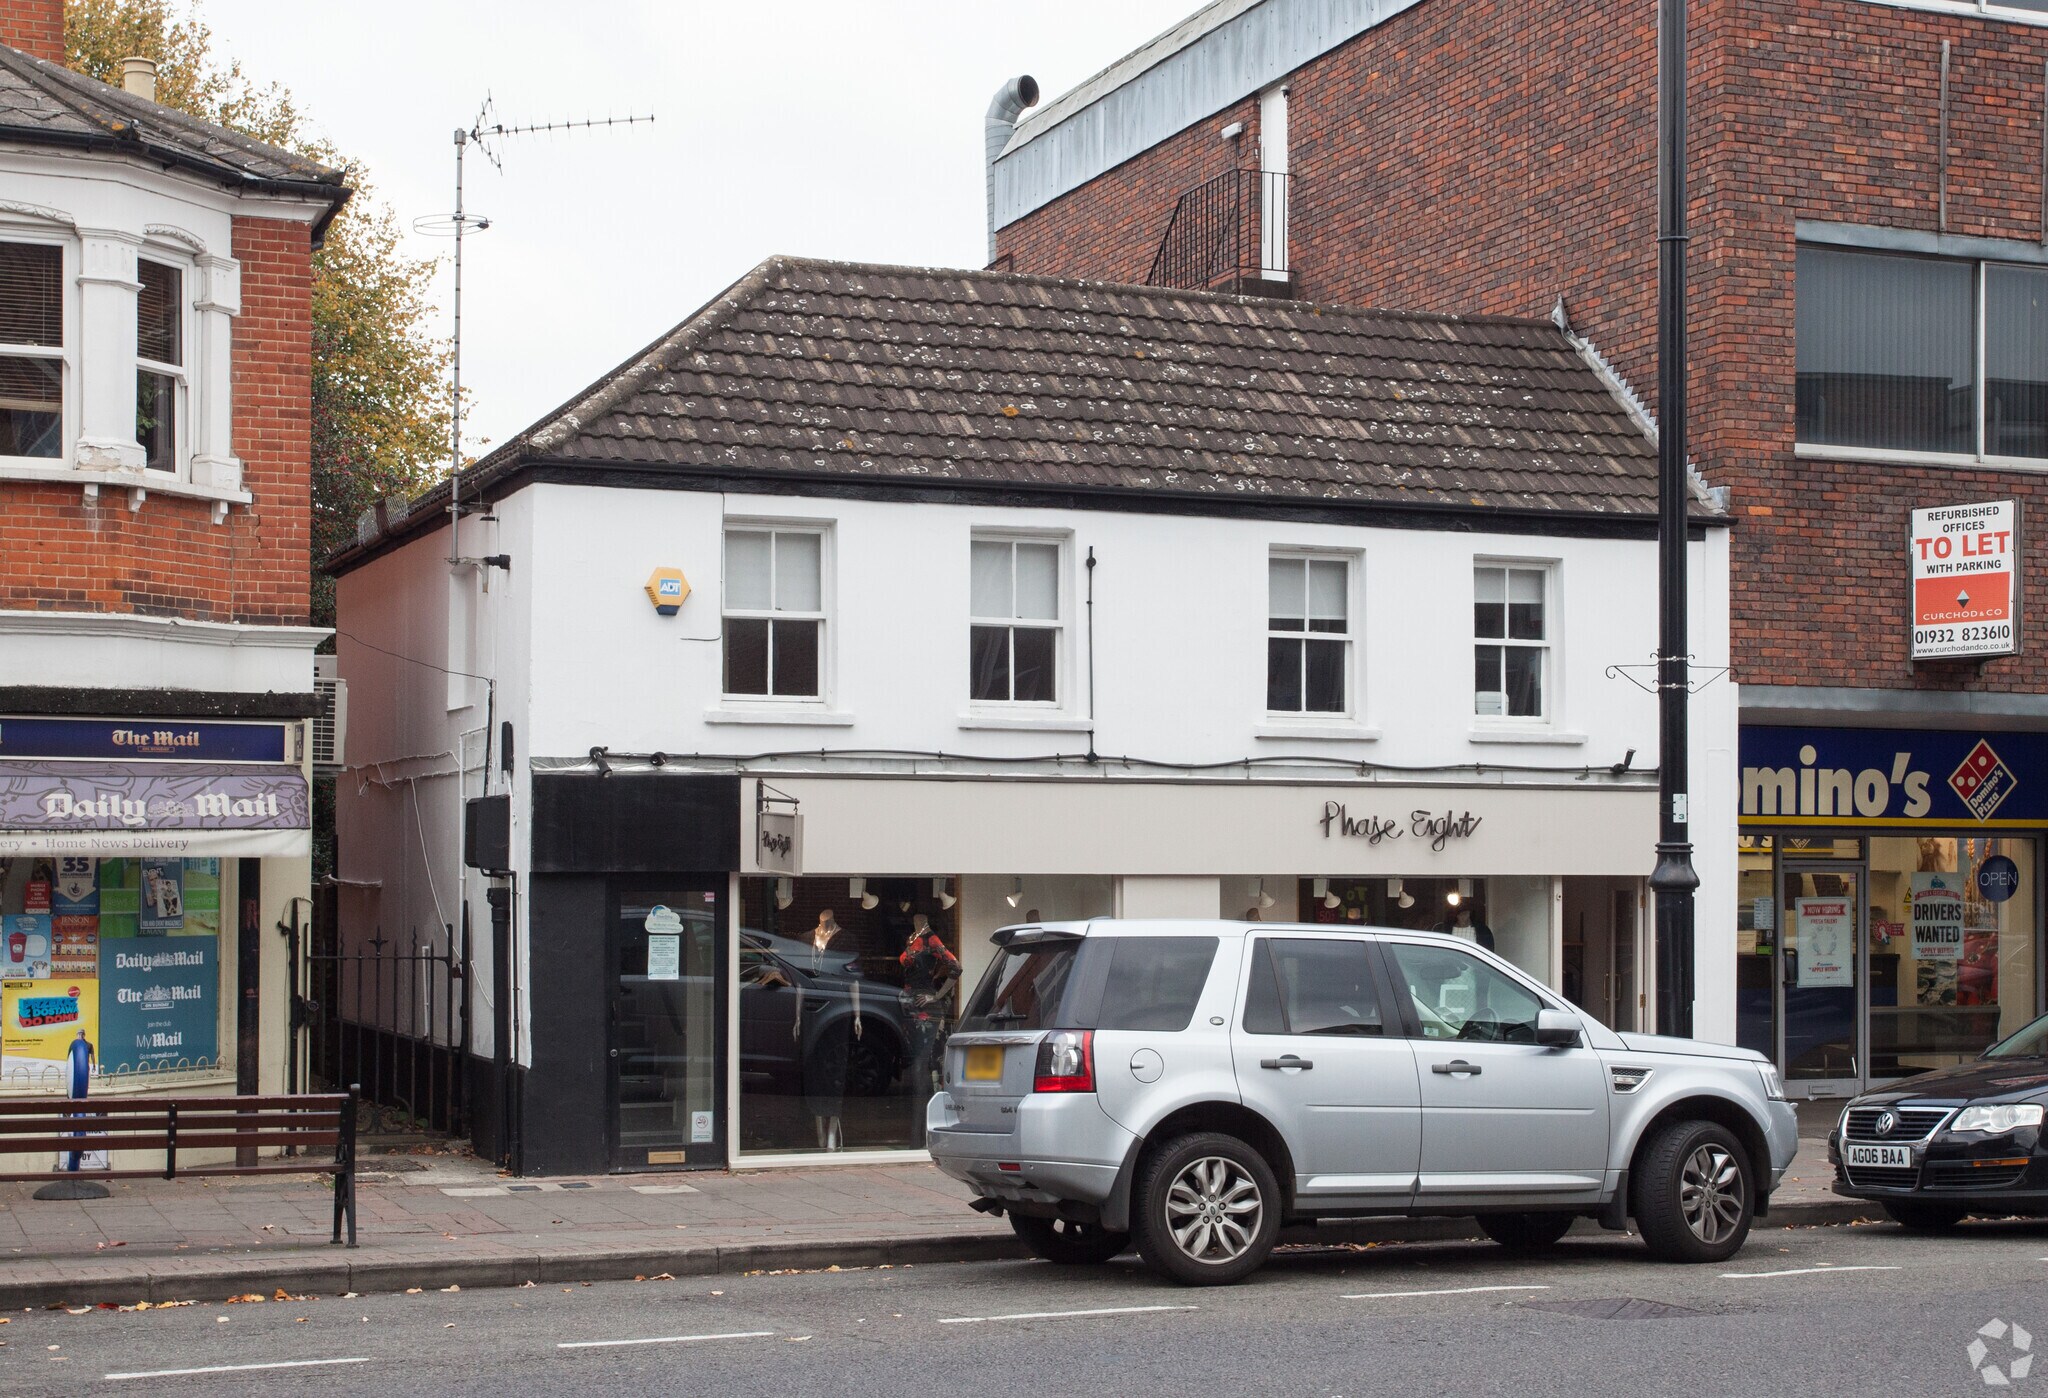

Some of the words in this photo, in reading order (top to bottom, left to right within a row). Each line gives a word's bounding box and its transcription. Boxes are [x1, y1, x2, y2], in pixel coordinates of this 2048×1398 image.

[1927, 506, 2000, 522] REFURBISHED
[1942, 520, 1985, 533] OFFICES
[1916, 536, 1952, 560] TO
[1962, 531, 2010, 557] LET
[1926, 562, 1953, 574] WITH
[1956, 560, 2002, 572] PARKING
[660, 582, 681, 593] ADT
[1915, 629, 1954, 644] 01932
[1962, 625, 2010, 642] 823610
[1916, 642, 2010, 654] www.curchodandco.co.uk
[112, 730, 150, 746] The
[152, 731, 200, 746] Mail
[1738, 744, 1932, 818] mino's
[1970, 769, 2004, 809] Domino's
[46, 793, 147, 825] Daily
[194, 792, 280, 818] Mail
[1976, 792, 2000, 818] Pizza
[1319, 800, 1404, 844] Phase
[1410, 810, 1483, 852] Eight
[46, 838, 87, 848] Home
[90, 838, 128, 848] News
[132, 838, 189, 851] Delivery
[62, 857, 90, 872] 35
[1980, 872, 2017, 886] OPEN
[1914, 904, 1962, 921] DRIVERS
[1915, 926, 1960, 943] WANTED
[116, 952, 152, 972] Daily
[174, 951, 204, 966] Mail
[117, 988, 143, 1004] The
[171, 985, 202, 1000] Mail
[1852, 1148, 1878, 1163] AG06
[1882, 1149, 1904, 1164] BAA
